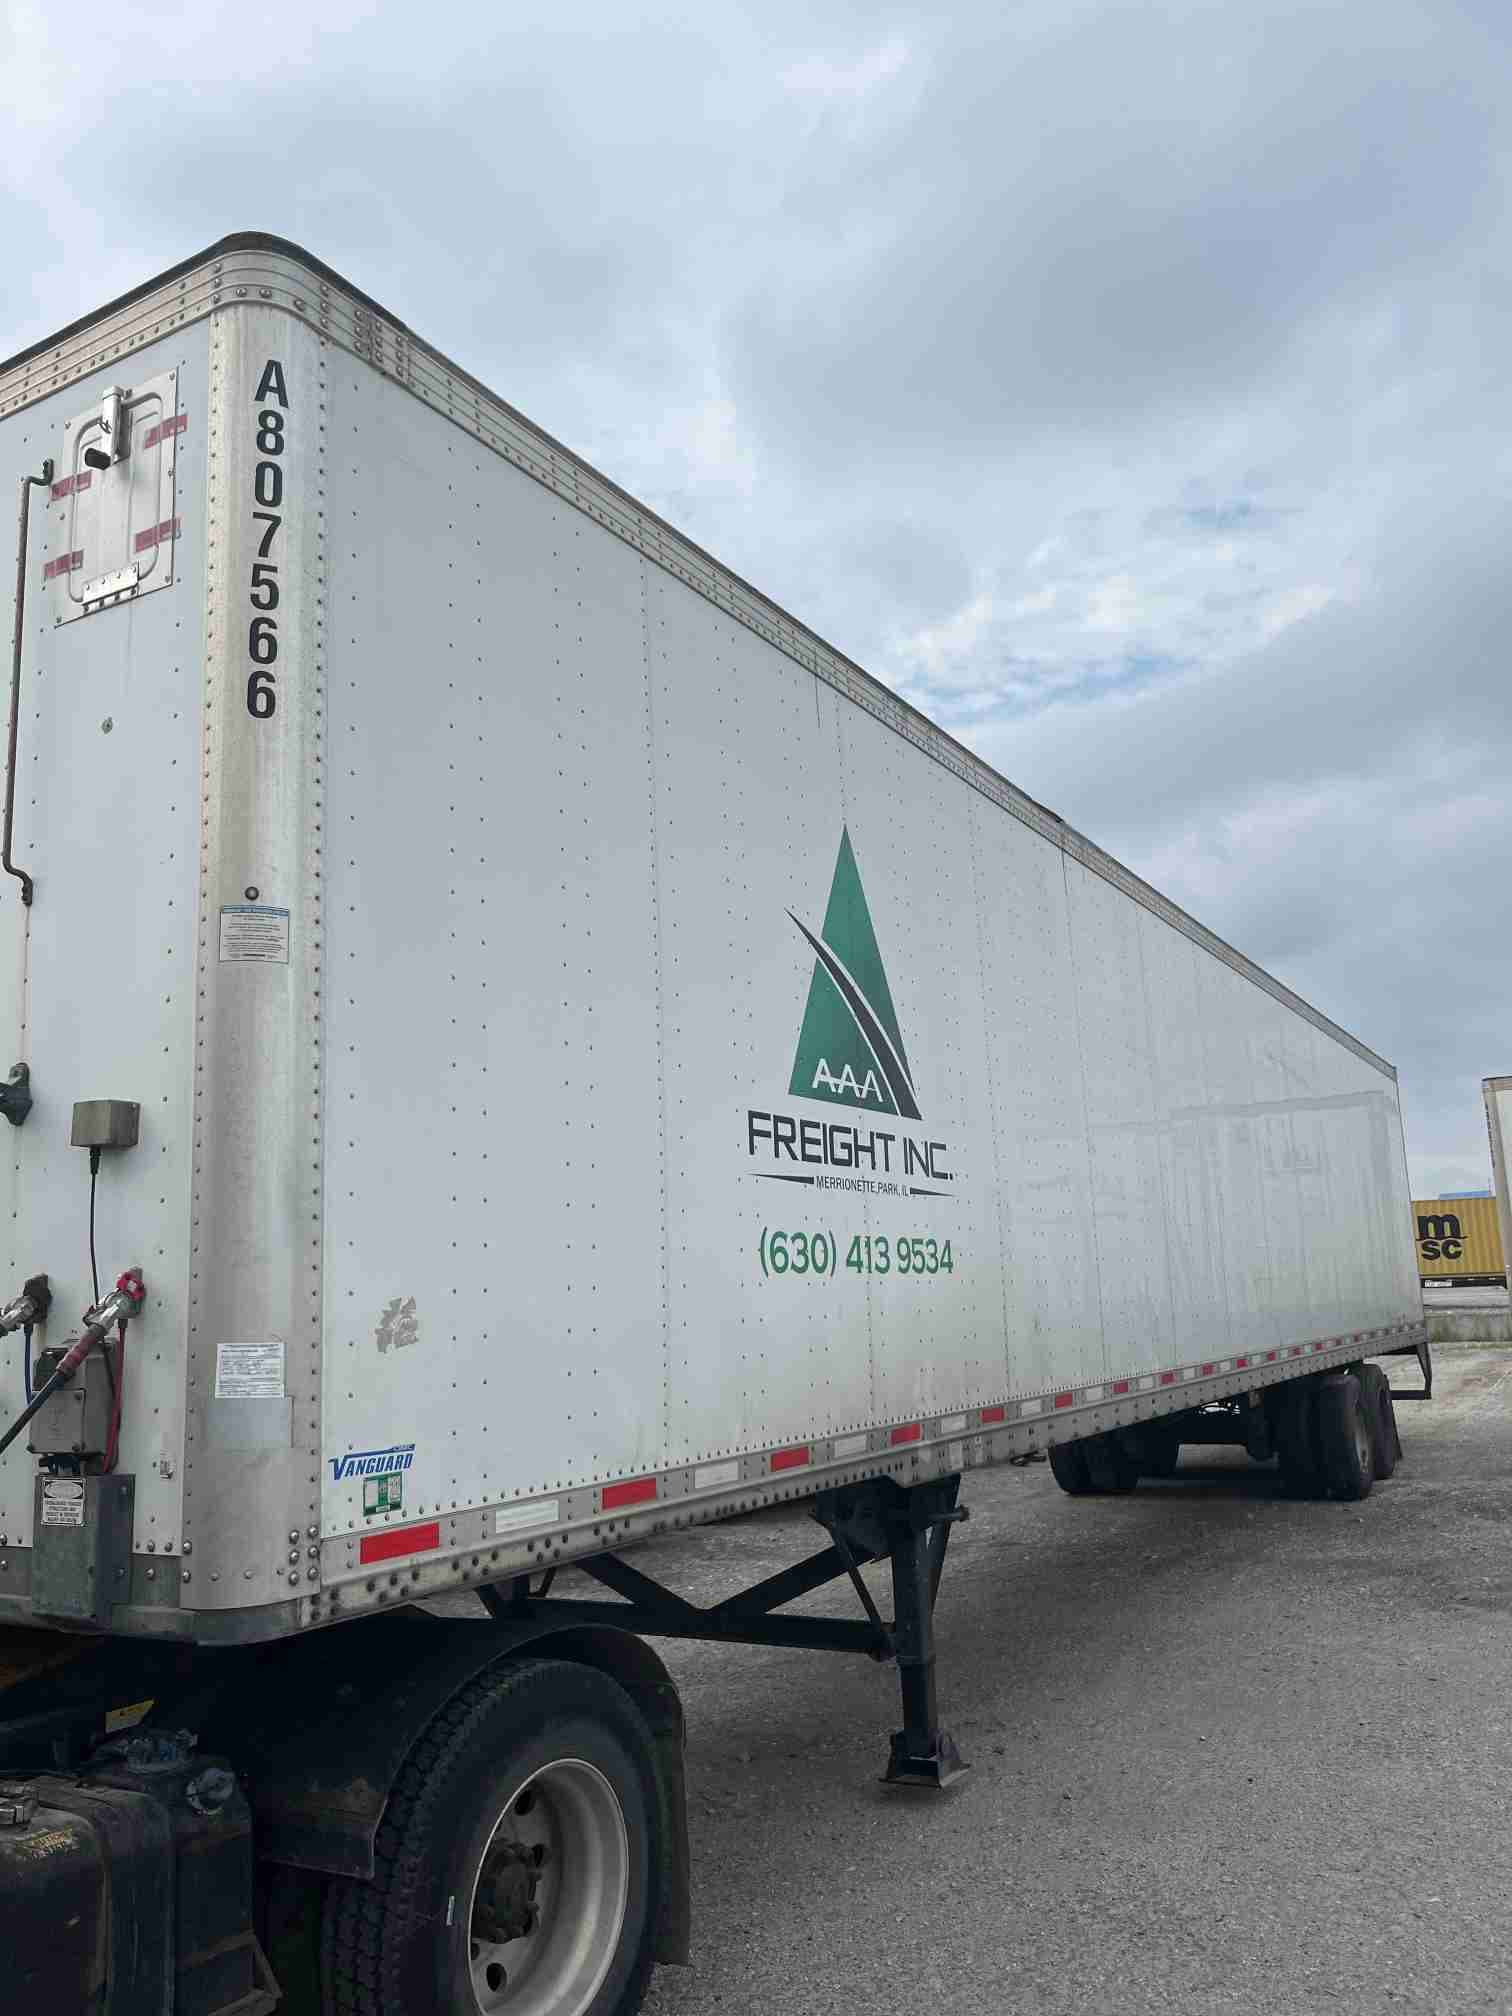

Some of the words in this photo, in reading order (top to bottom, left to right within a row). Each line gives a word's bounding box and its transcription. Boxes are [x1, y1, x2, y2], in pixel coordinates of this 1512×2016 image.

[246, 359, 289, 719] A807566
[812, 1058, 883, 1103] AAA
[748, 1110, 896, 1173] FREIGHT
[902, 1136, 953, 1181] INC.
[816, 1175, 876, 1193] MERRIONETTE
[760, 1226, 837, 1278] (630)
[846, 1235, 891, 1274] 413
[896, 1236, 954, 1274] 9534
[328, 1452, 414, 1480] VANGUARD
